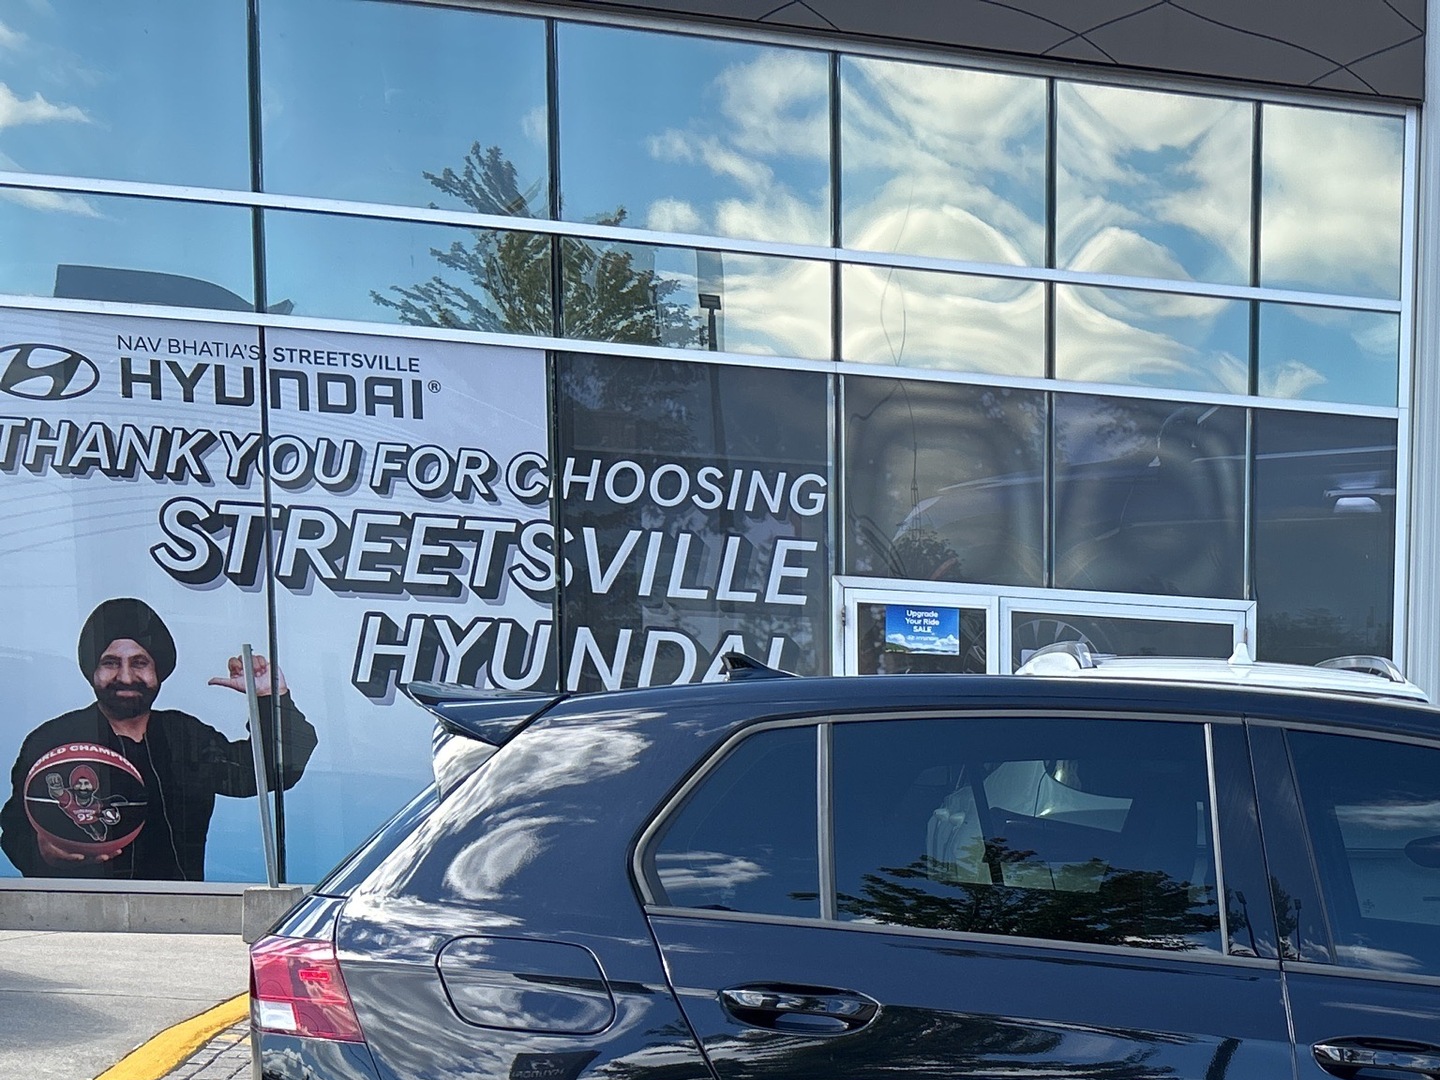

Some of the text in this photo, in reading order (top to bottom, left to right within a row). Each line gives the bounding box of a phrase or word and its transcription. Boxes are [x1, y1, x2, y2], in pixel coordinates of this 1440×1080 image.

[117, 334, 420, 373] NAV BHATIA'S STREETSVILLE
[0, 416, 827, 516] THANK YOU FOR CHOOSING
[151, 495, 819, 606] STREETSVILLE
[906, 610, 939, 618] Upgrade
[923, 618, 940, 626] Ride
